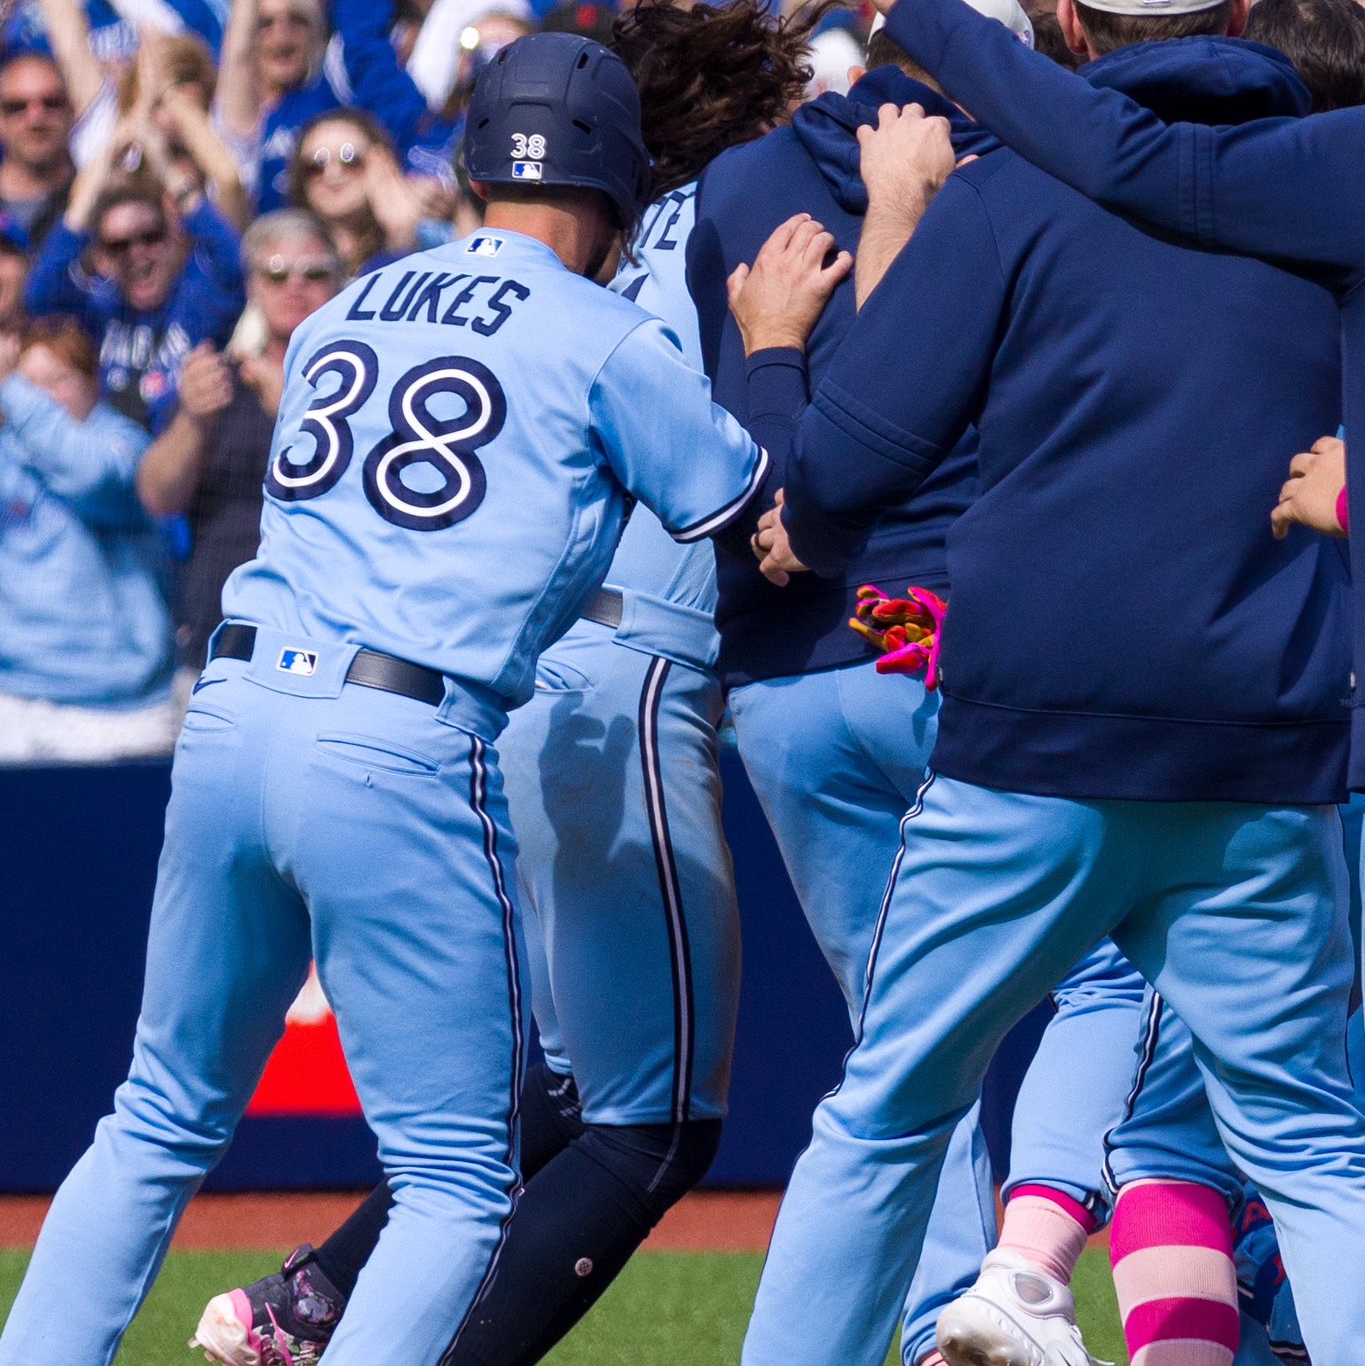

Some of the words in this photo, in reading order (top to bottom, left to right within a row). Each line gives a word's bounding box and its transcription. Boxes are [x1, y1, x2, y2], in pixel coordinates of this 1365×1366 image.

[510, 132, 546, 160] 38
[349, 271, 529, 336] LUKES
[266, 341, 507, 531] 38
